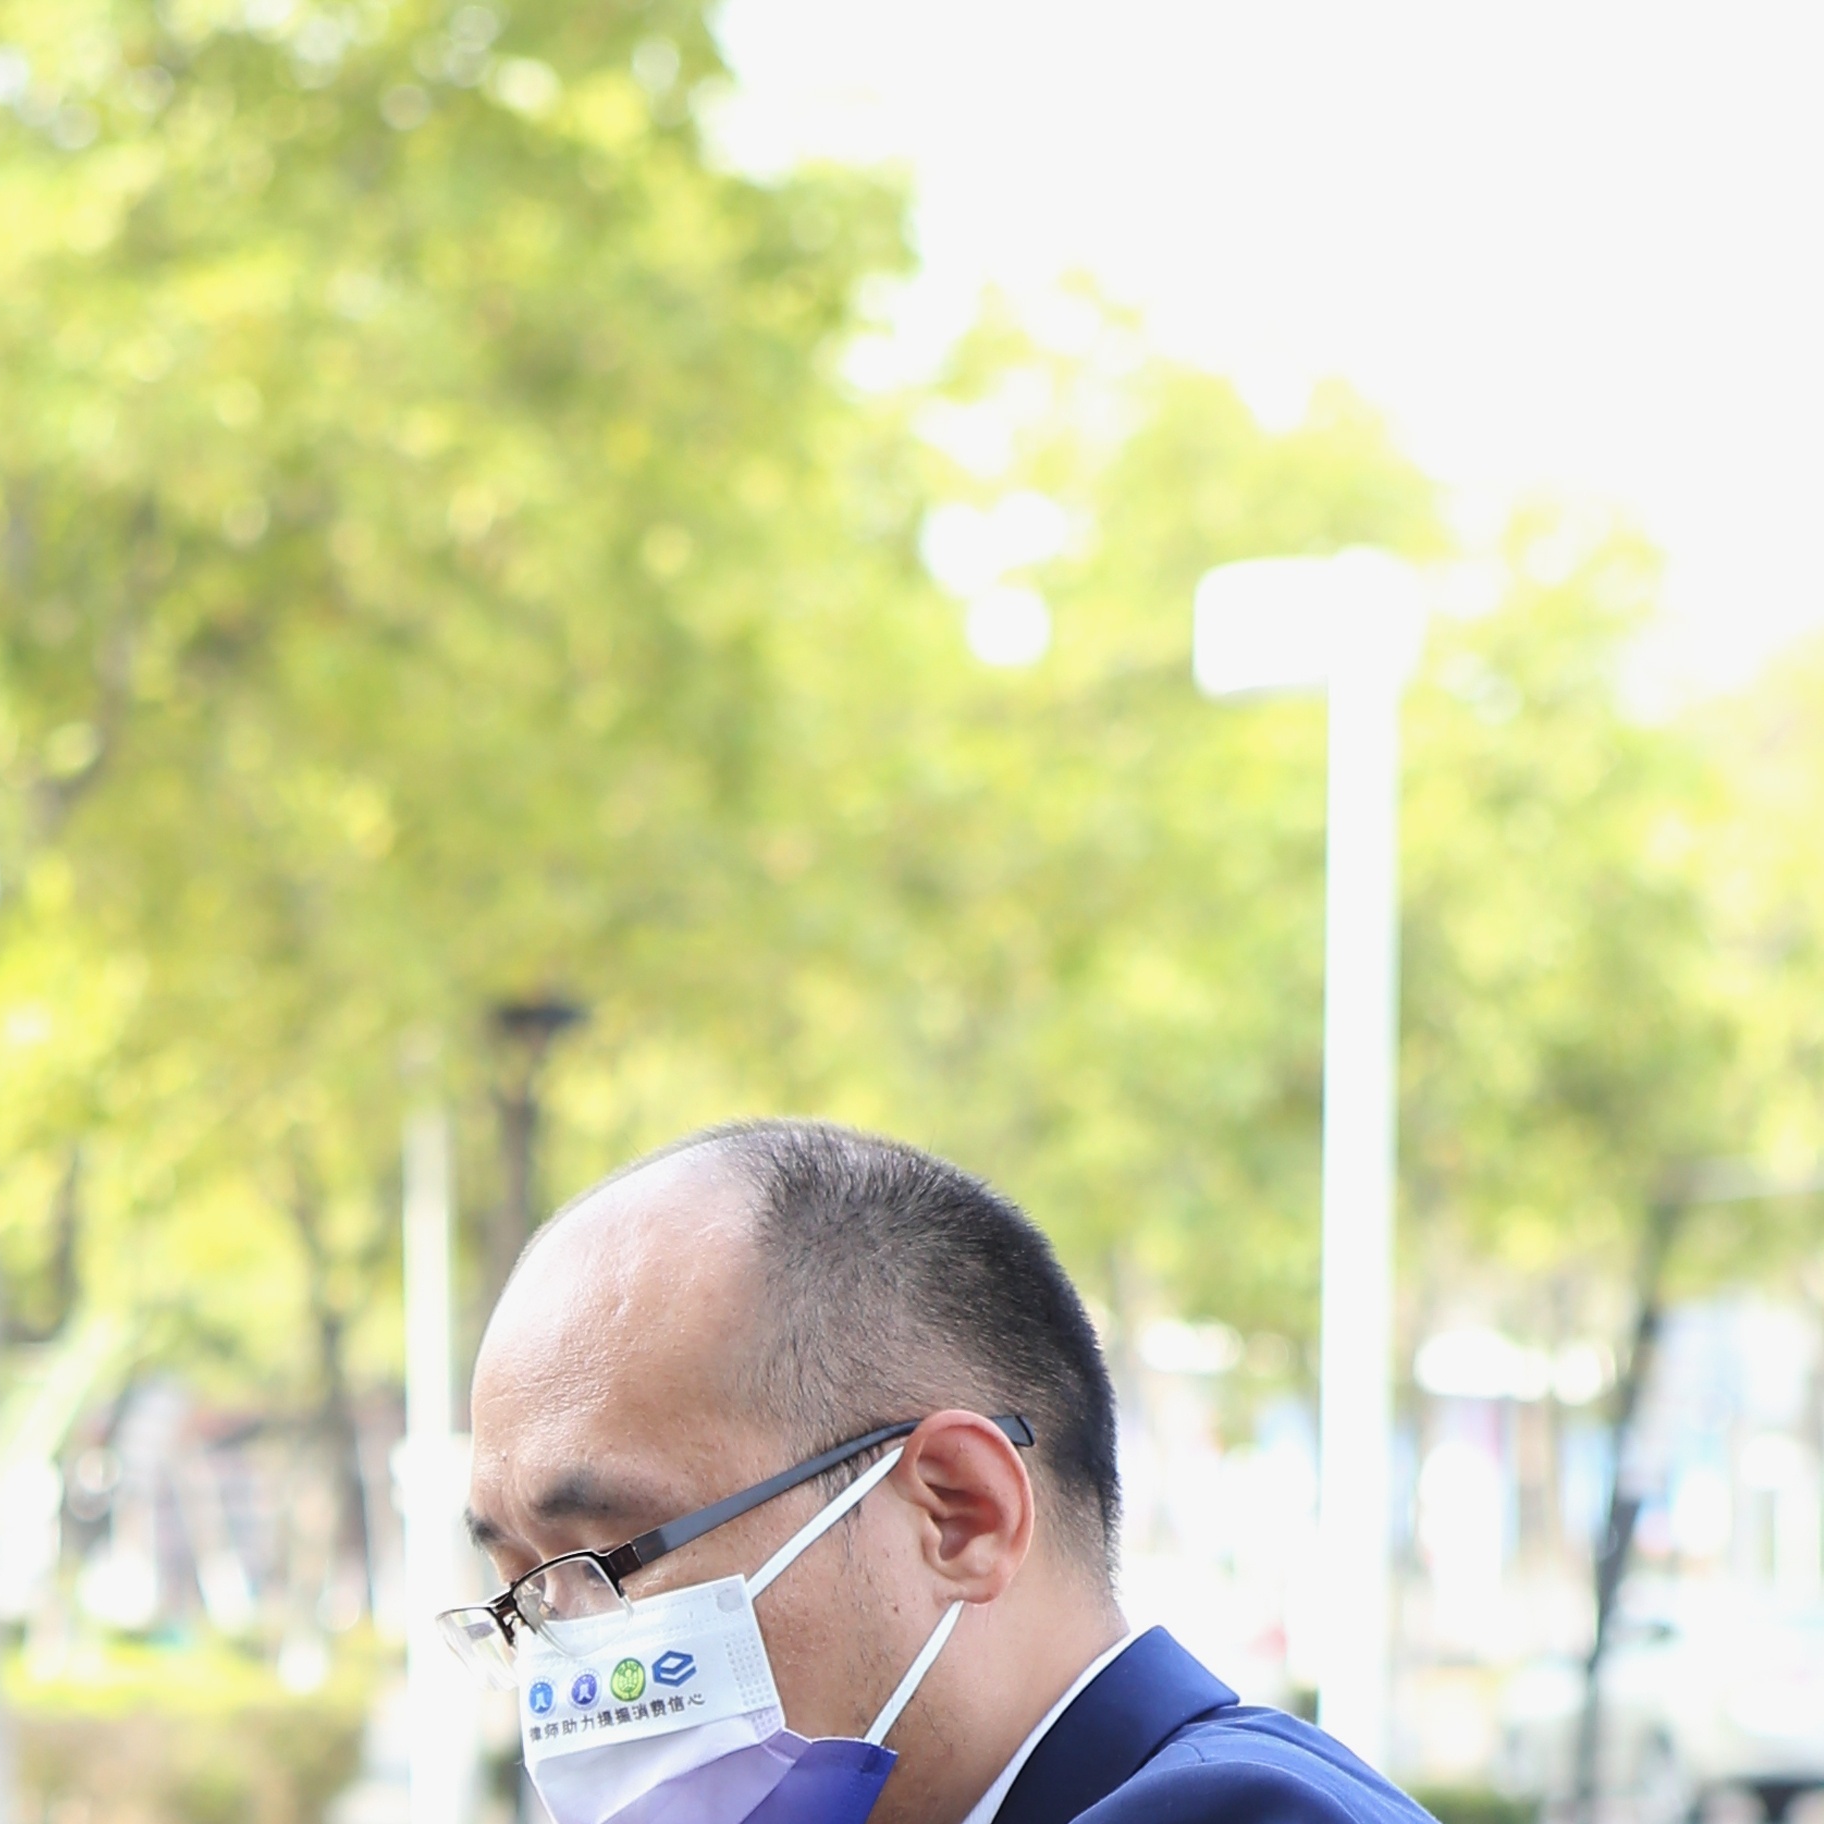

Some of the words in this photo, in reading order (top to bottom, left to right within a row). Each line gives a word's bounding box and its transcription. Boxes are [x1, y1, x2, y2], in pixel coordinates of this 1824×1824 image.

[529, 1692, 706, 1743] 律师助力提振消费信心
